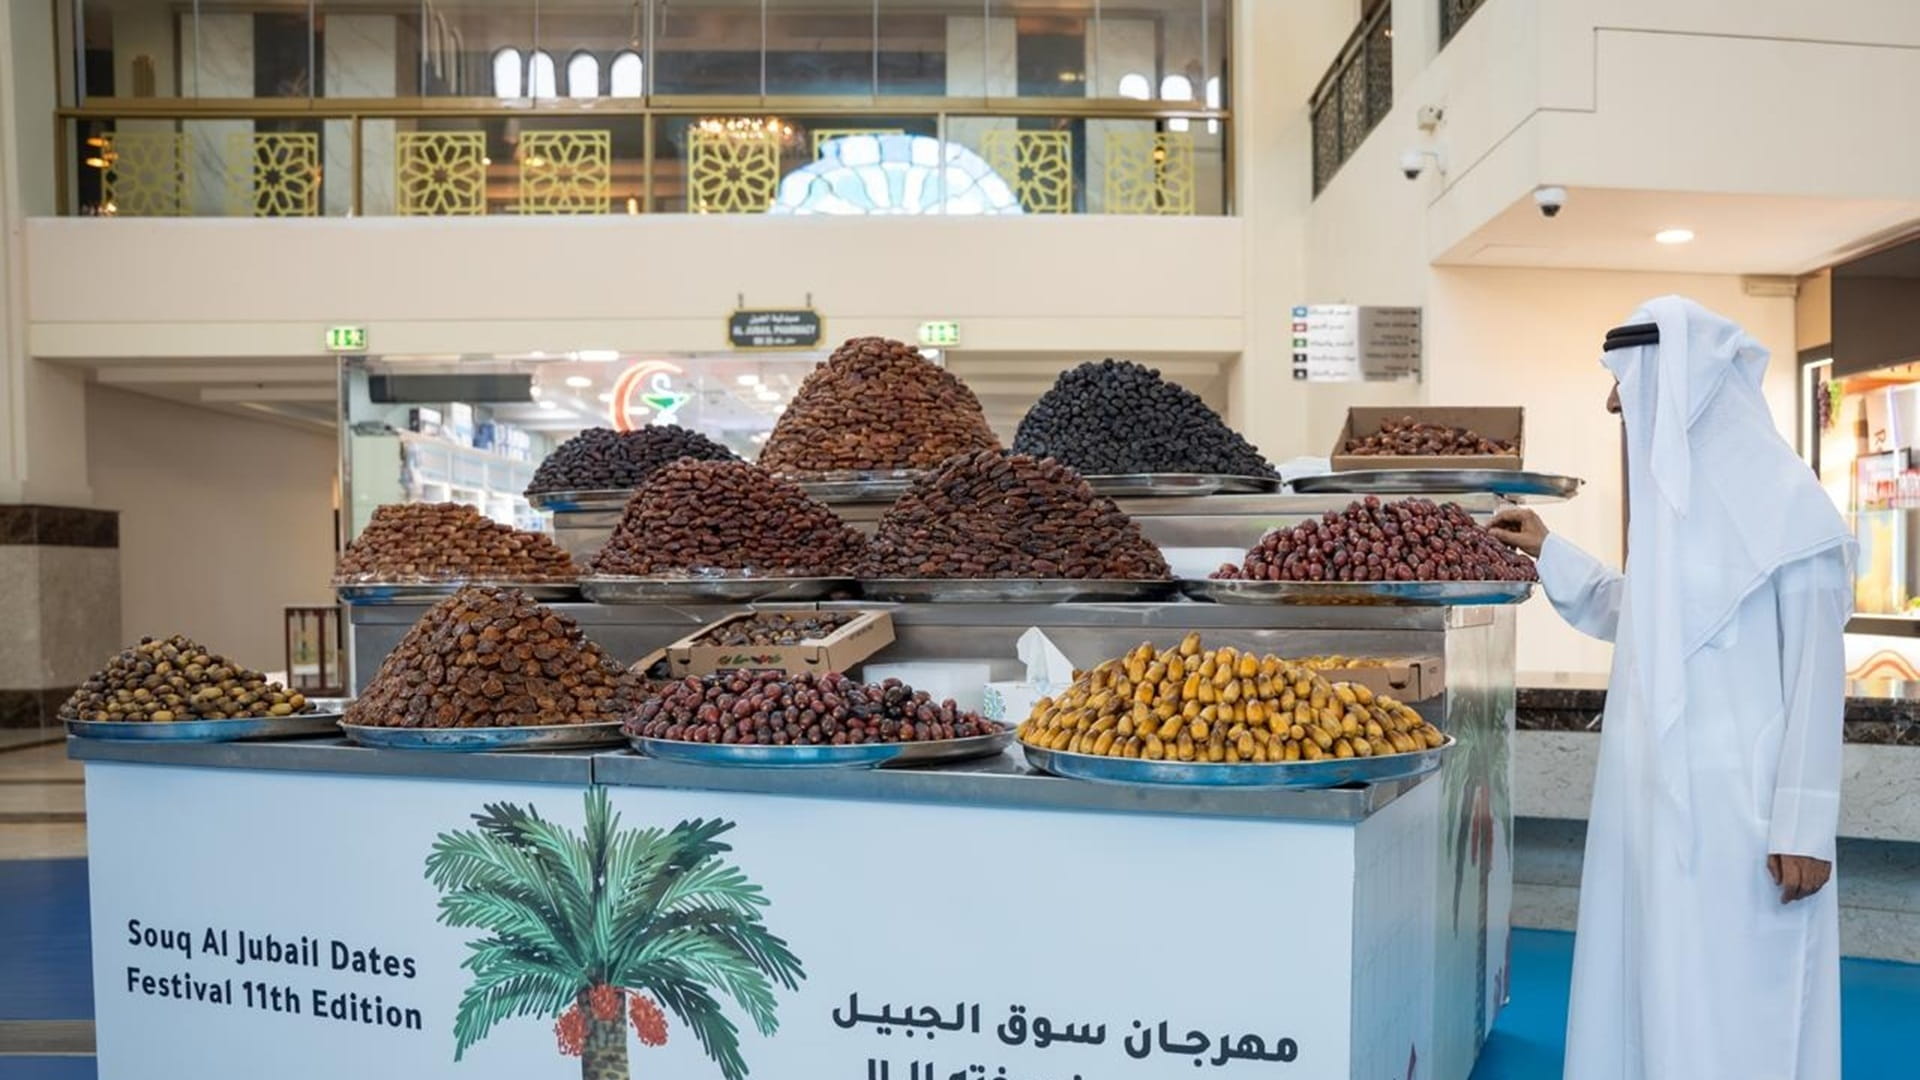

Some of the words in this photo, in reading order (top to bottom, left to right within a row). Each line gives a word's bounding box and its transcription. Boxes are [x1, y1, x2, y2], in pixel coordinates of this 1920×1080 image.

[127, 919, 192, 960] Souq
[202, 927, 228, 957] Al
[236, 930, 319, 967] Jubail
[331, 940, 417, 979] Dates
[127, 966, 232, 1005] Festival
[242, 981, 301, 1014] 11th
[312, 989, 422, 1030] Edition
[832, 992, 980, 1040] الجبيل
[997, 1004, 1106, 1049] سوق
[1124, 1020, 1298, 1067] مهرجان
